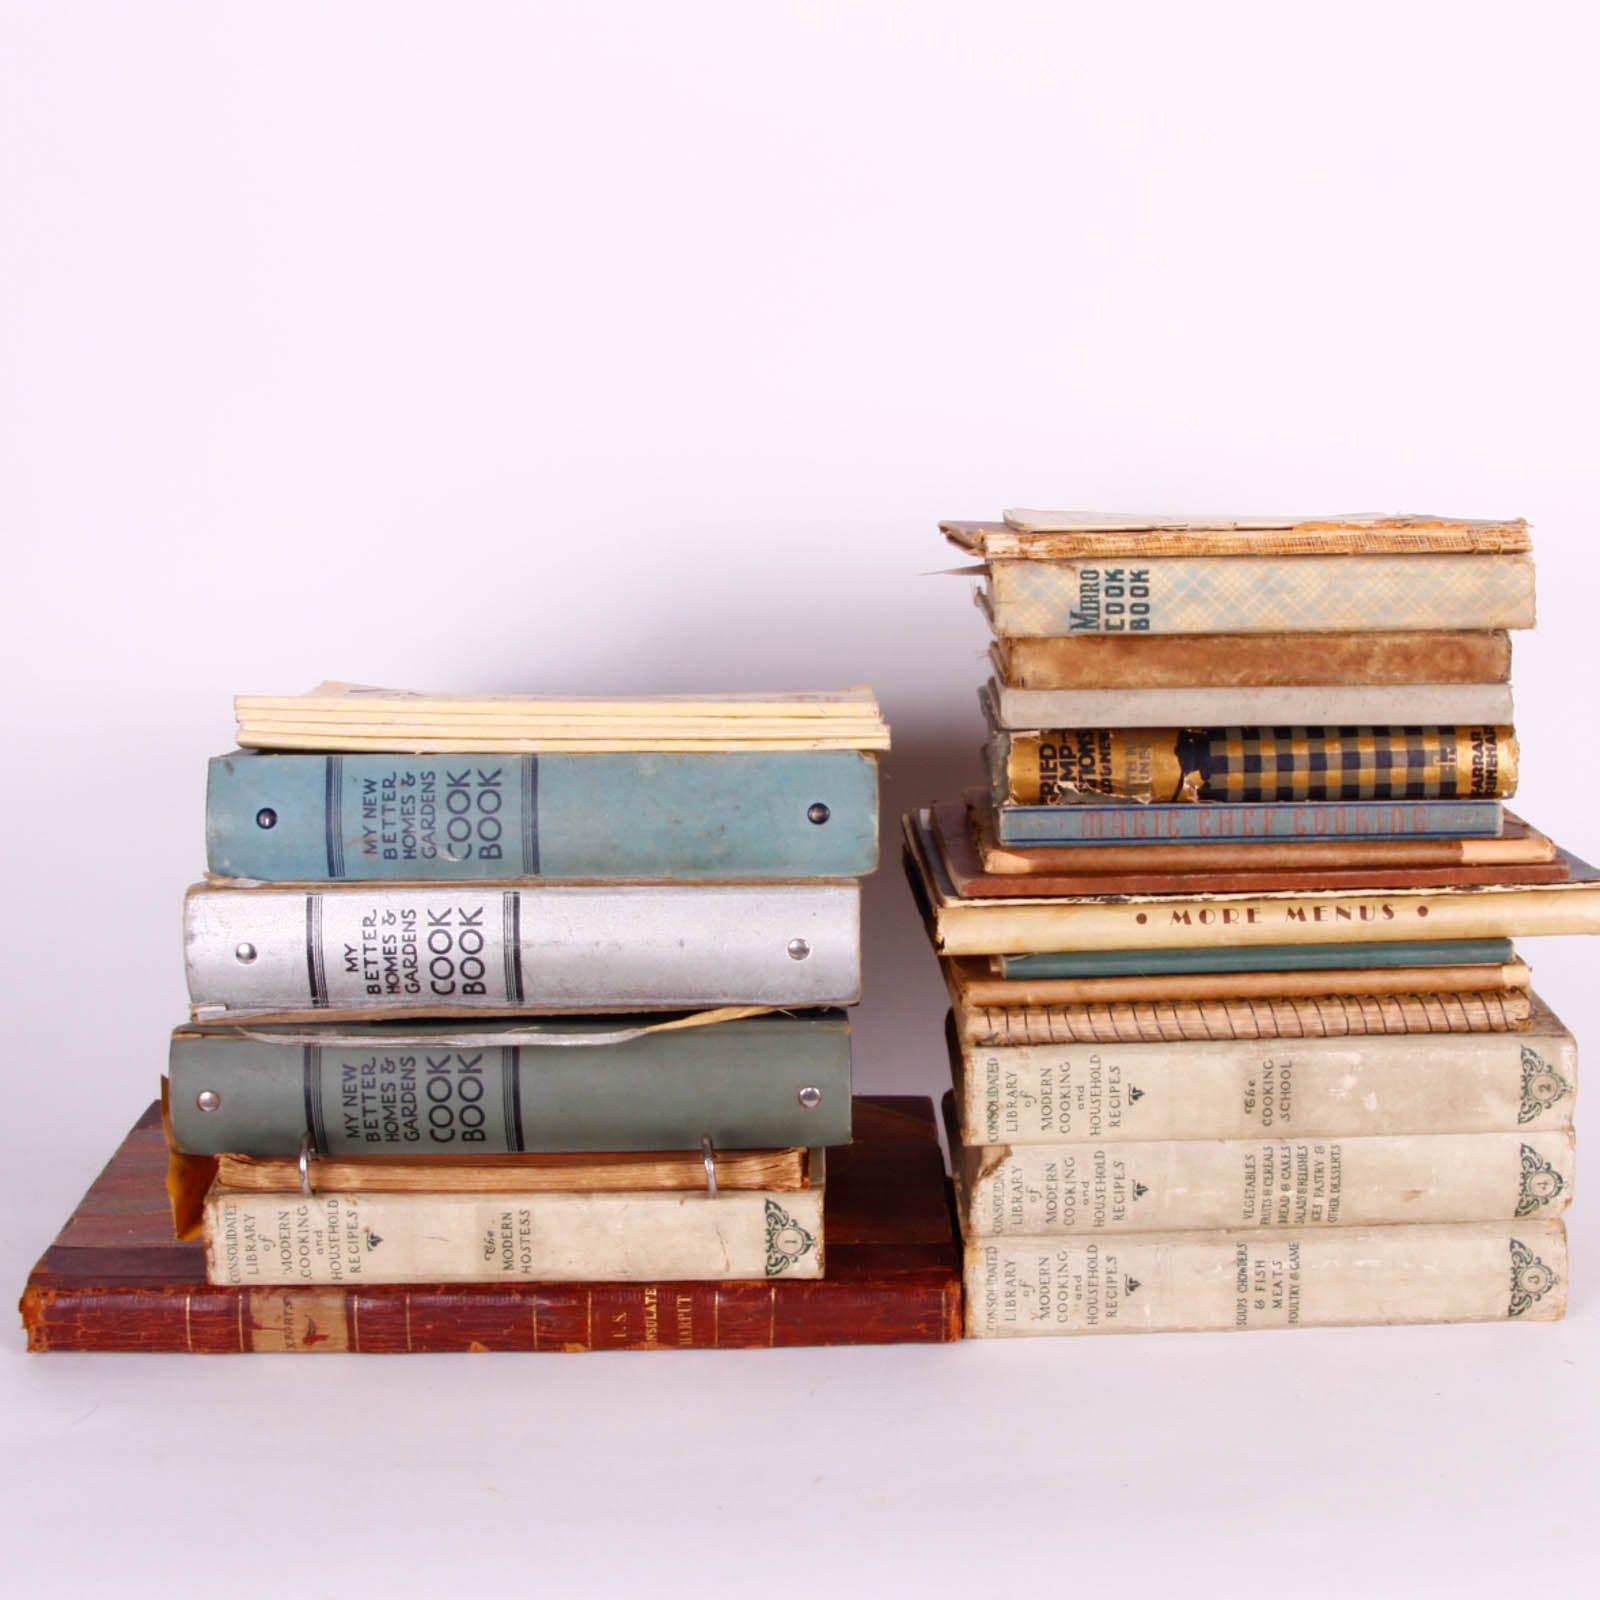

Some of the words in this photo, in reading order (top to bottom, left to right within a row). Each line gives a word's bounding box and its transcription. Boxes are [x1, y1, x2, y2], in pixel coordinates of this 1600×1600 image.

[1069, 569, 1100, 631] MIRRO
[1104, 569, 1125, 631] COOK
[1130, 569, 1150, 631] BOOK
[401, 771, 416, 787] &
[1471, 731, 1484, 796] FARRAR
[362, 778, 378, 819] NEW
[382, 771, 398, 860] BETTER
[401, 795, 417, 859] HOMES
[420, 771, 438, 860] GARDENS
[446, 768, 472, 861] COOK
[476, 768, 502, 860] BOOK
[1081, 808, 1181, 838] MAGIC
[1199, 807, 1278, 837] CHEF
[1293, 805, 1429, 835] COOKING
[362, 825, 378, 855] MY
[382, 909, 397, 926] &
[1169, 908, 1262, 926] MORE
[1285, 904, 1395, 922] MENUS
[344, 943, 359, 972] MY
[363, 909, 381, 994] BETTER
[382, 934, 401, 994] HOMES
[401, 908, 421, 994] GARDENS
[427, 906, 456, 995] COOK
[458, 906, 487, 995] BOOK
[342, 1064, 358, 1107] NEW
[380, 1057, 396, 1073] &
[1090, 1054, 1101, 1136] HOUSEHOLD
[1108, 1065, 1121, 1127] RECIPES
[1262, 1059, 1274, 1127] COOKING
[1280, 1060, 1292, 1122] SCHOOL
[344, 1113, 361, 1139] MY
[361, 1056, 381, 1142] BETTER
[381, 1082, 399, 1142] HOMES
[400, 1056, 420, 1142] GARDENS
[426, 1054, 456, 1143] COOK
[457, 1053, 486, 1142] BOOK
[1005, 1072, 1018, 1132] LIBRARY
[1019, 1090, 1037, 1108] of
[1040, 1068, 1053, 1131] MODERN
[1059, 1062, 1071, 1134] COOKING
[1075, 1085, 1085, 1110] and
[1011, 1166, 1023, 1225] LIBRARY
[1026, 1185, 1042, 1203] of
[1046, 1163, 1058, 1224] MODERN
[1063, 1156, 1076, 1226] COOKING
[1080, 1181, 1090, 1206] and
[1093, 1150, 1106, 1227] HOUSEHOLD
[1112, 1161, 1126, 1221] RECIPES
[1243, 1154, 1256, 1220] VEGETABLES
[1313, 1160, 1325, 1198] PASTRY
[243, 1214, 259, 1275] LIBRARY
[258, 1233, 276, 1251] of
[278, 1211, 293, 1275] MODERN
[297, 1205, 312, 1280] COOKING
[314, 1230, 324, 1255] and
[327, 1199, 343, 1280] HOUSEHOLD
[347, 1210, 361, 1274] RECIPES
[501, 1212, 514, 1271] MODERN
[519, 1209, 532, 1274] HOSTESS
[1289, 1240, 1300, 1271] GAME
[1005, 1260, 1017, 1321] LIBRARY
[1019, 1280, 1036, 1298] of
[1039, 1257, 1051, 1321] MODERN
[1057, 1250, 1069, 1323] COOKING
[1073, 1275, 1083, 1301] and
[1087, 1244, 1098, 1325] HOUSEHOLD
[1105, 1256, 1118, 1318] RECIPES
[1255, 1260, 1265, 1292] FISH
[1272, 1260, 1282, 1309] MEATS
[1236, 1297, 1248, 1326] SOUPS
